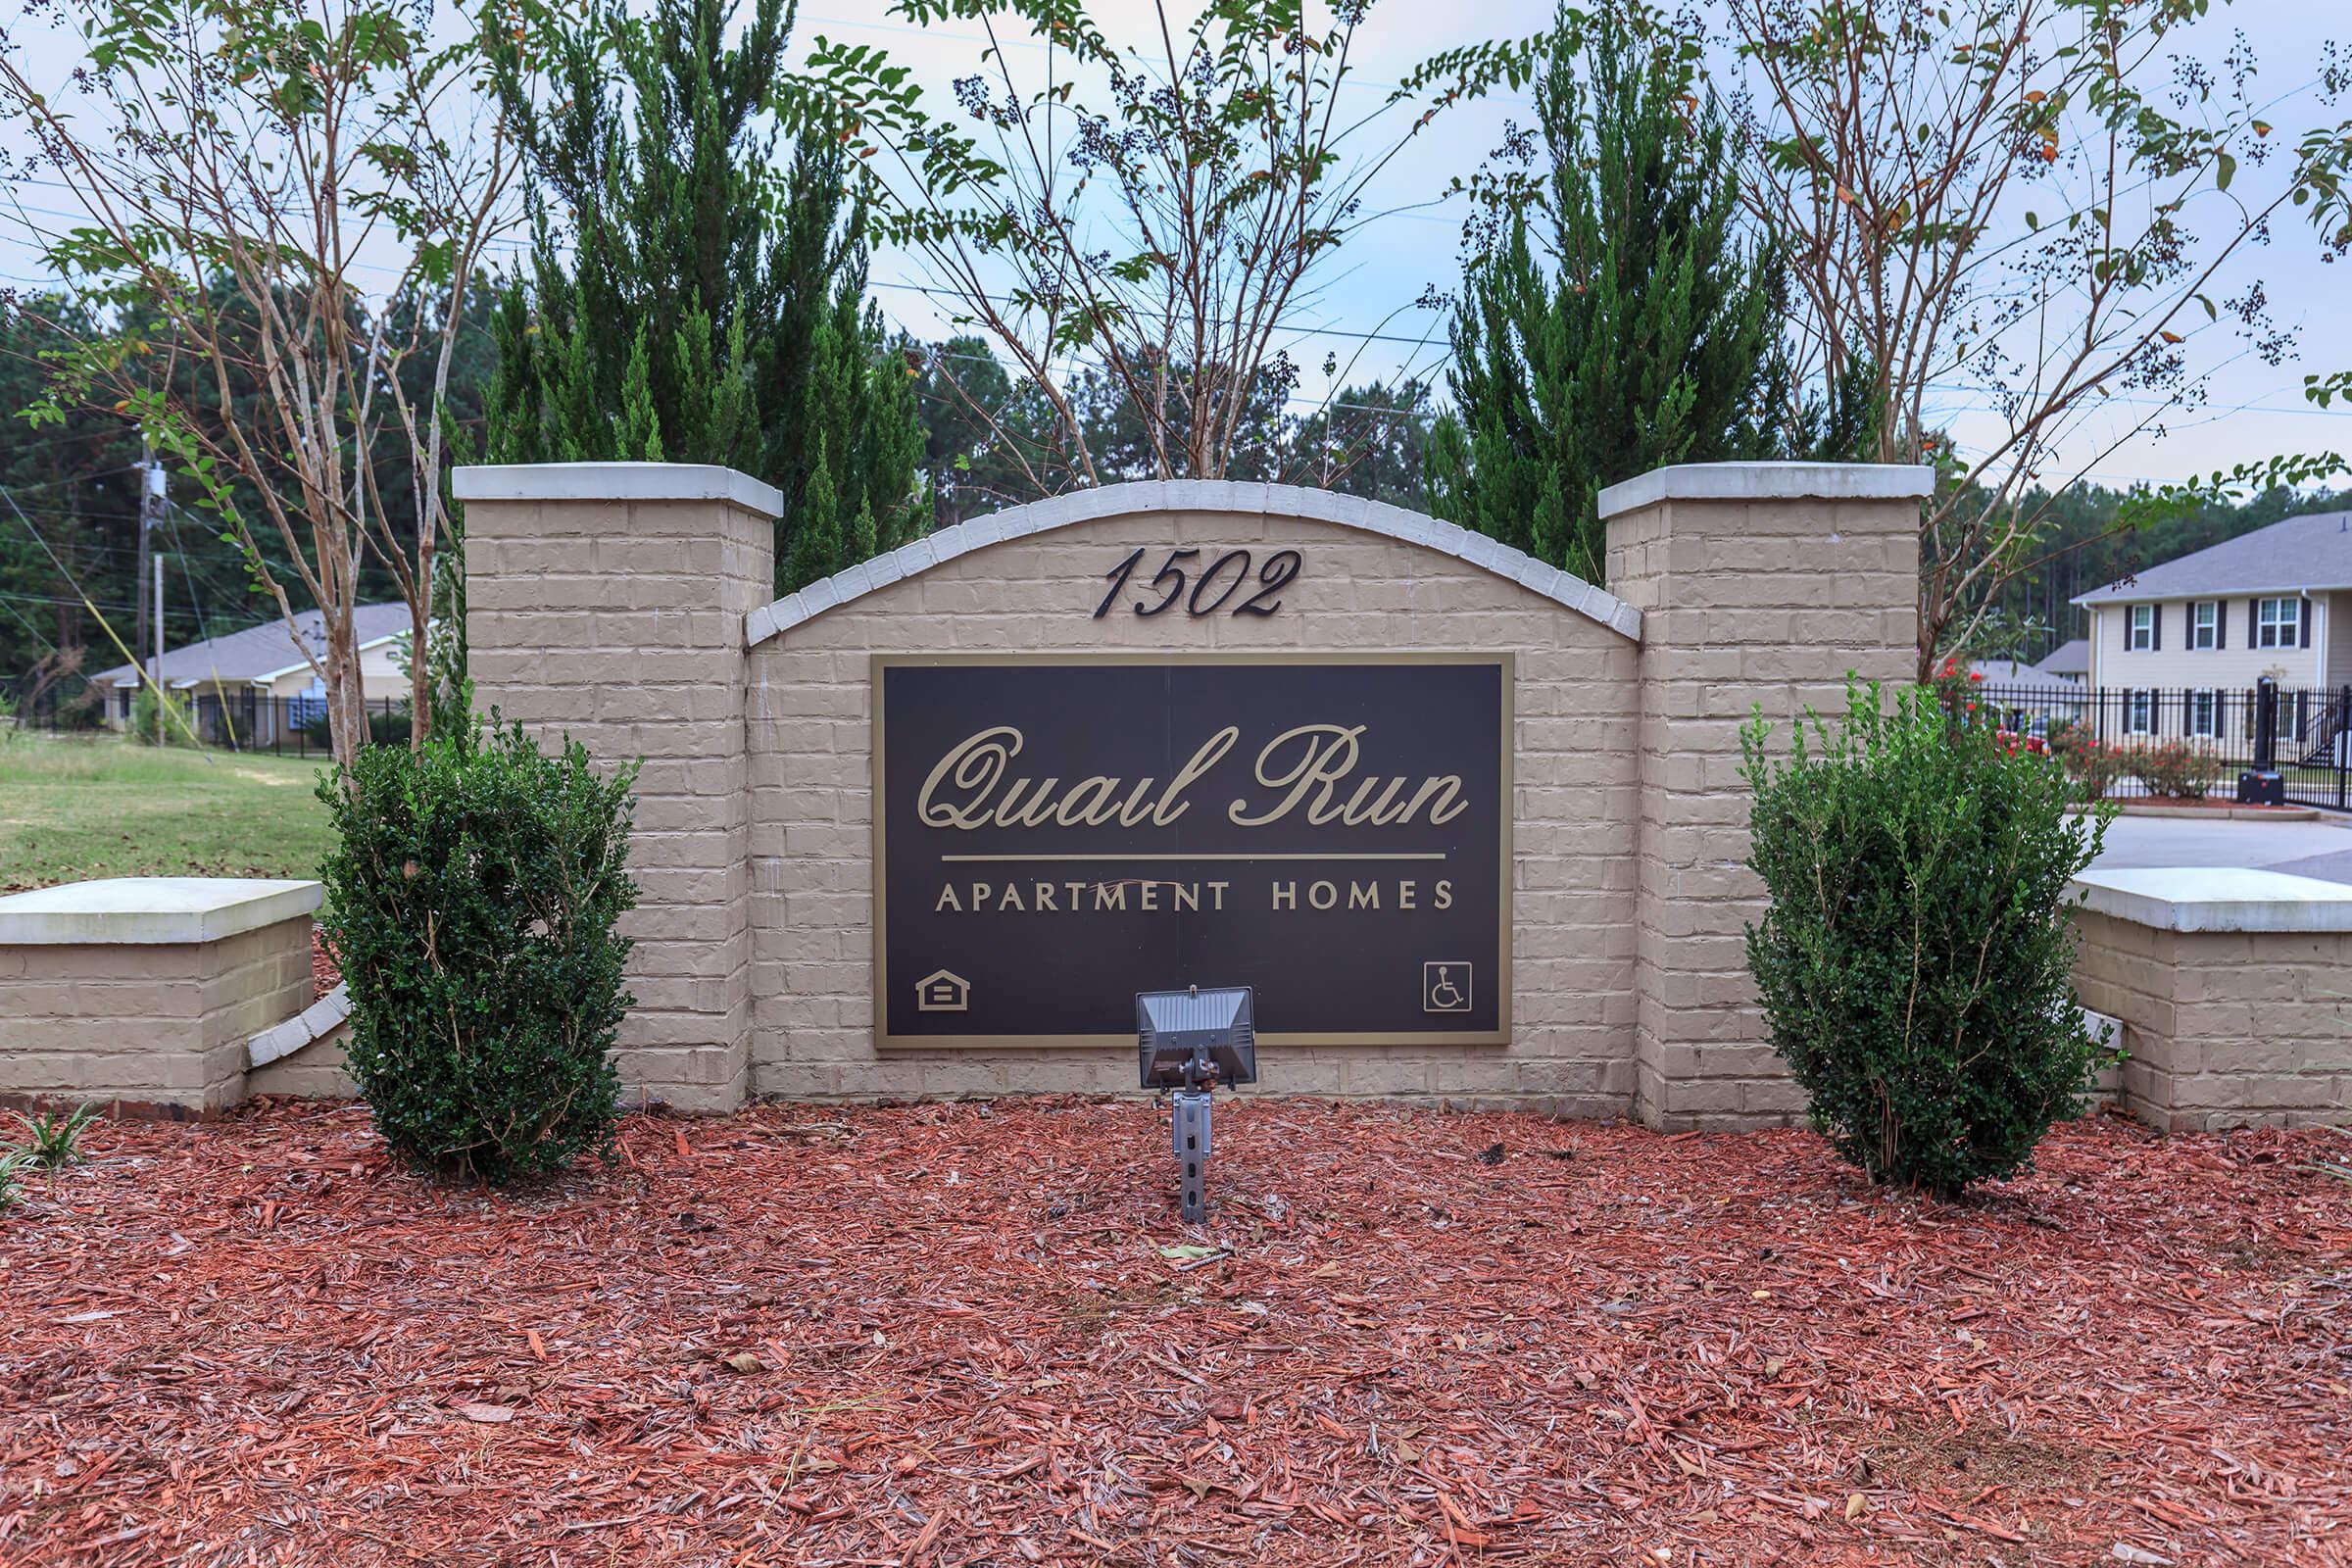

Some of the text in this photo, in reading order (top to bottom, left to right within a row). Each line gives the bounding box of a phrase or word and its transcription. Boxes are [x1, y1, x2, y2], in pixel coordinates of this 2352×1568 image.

[1094, 546, 1303, 618] 1502
[916, 723, 1469, 830] Quail Run
[935, 880, 1453, 912] APARTMENT HOMES
